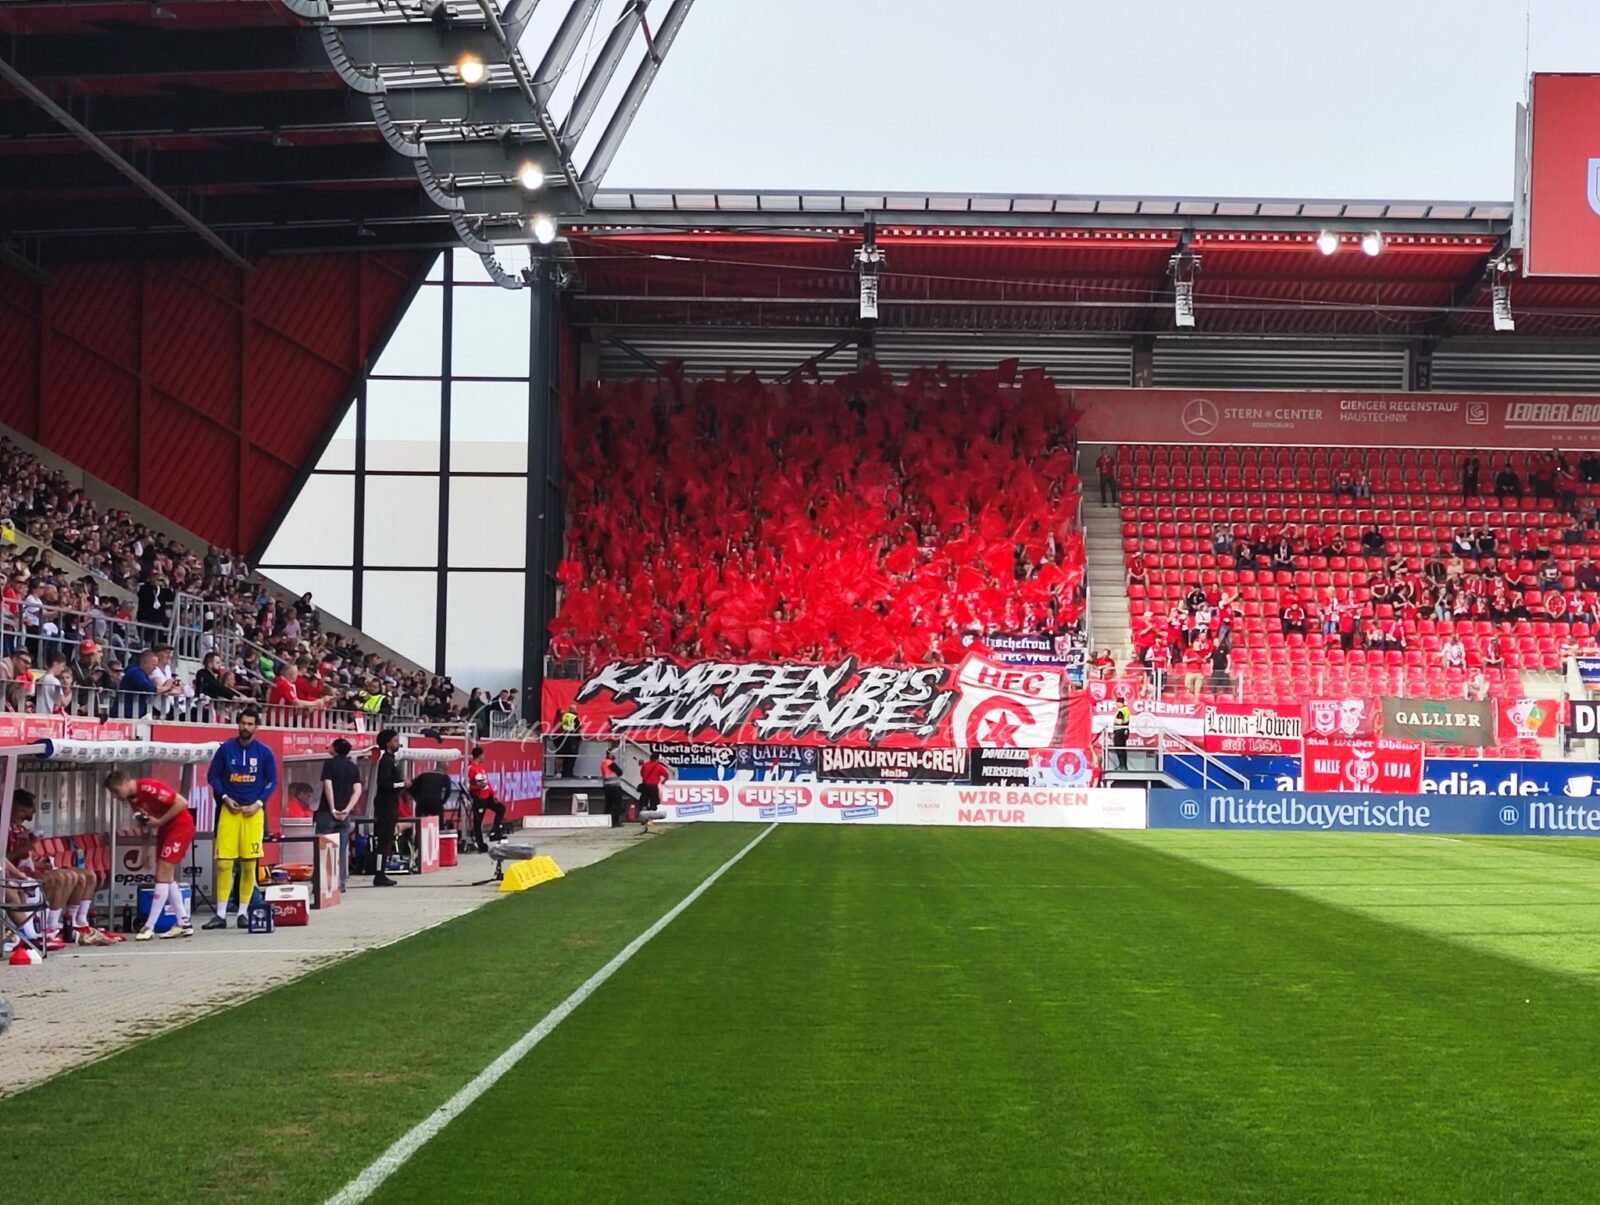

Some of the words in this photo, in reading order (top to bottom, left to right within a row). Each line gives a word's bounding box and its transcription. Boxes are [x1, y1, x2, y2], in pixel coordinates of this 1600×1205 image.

[1224, 408, 1263, 419] STERN
[1275, 409, 1323, 420] CENTER
[1340, 400, 1388, 411] GIENGER
[1389, 401, 1460, 413] REGENSTAUF
[1340, 412, 1408, 422] HAUSTECHNIK
[850, 666, 945, 701] BIS
[978, 666, 1045, 695] HFC
[1096, 702, 1125, 713] HF
[1133, 701, 1196, 714] CHEMIE
[611, 693, 757, 734] ZUM
[755, 690, 953, 741] ENDE!
[1207, 707, 1300, 737] Leuna-Löwen
[1396, 712, 1481, 727] GALLIER
[1576, 704, 1600, 733] D
[691, 744, 718, 754] Cre
[822, 748, 966, 775] BADKURVEN-CREW
[1314, 759, 1341, 774] HALLE
[880, 768, 909, 778] Halle
[1384, 762, 1411, 779] LUJA
[662, 788, 724, 803] FUSSL
[745, 789, 807, 804] FUSSL
[827, 790, 888, 806] FUSSL
[958, 790, 1002, 804] WIR
[1006, 791, 1089, 806] BACKEN
[958, 809, 1025, 823] NATUR
[1210, 795, 1431, 829] Mittelbayerische
